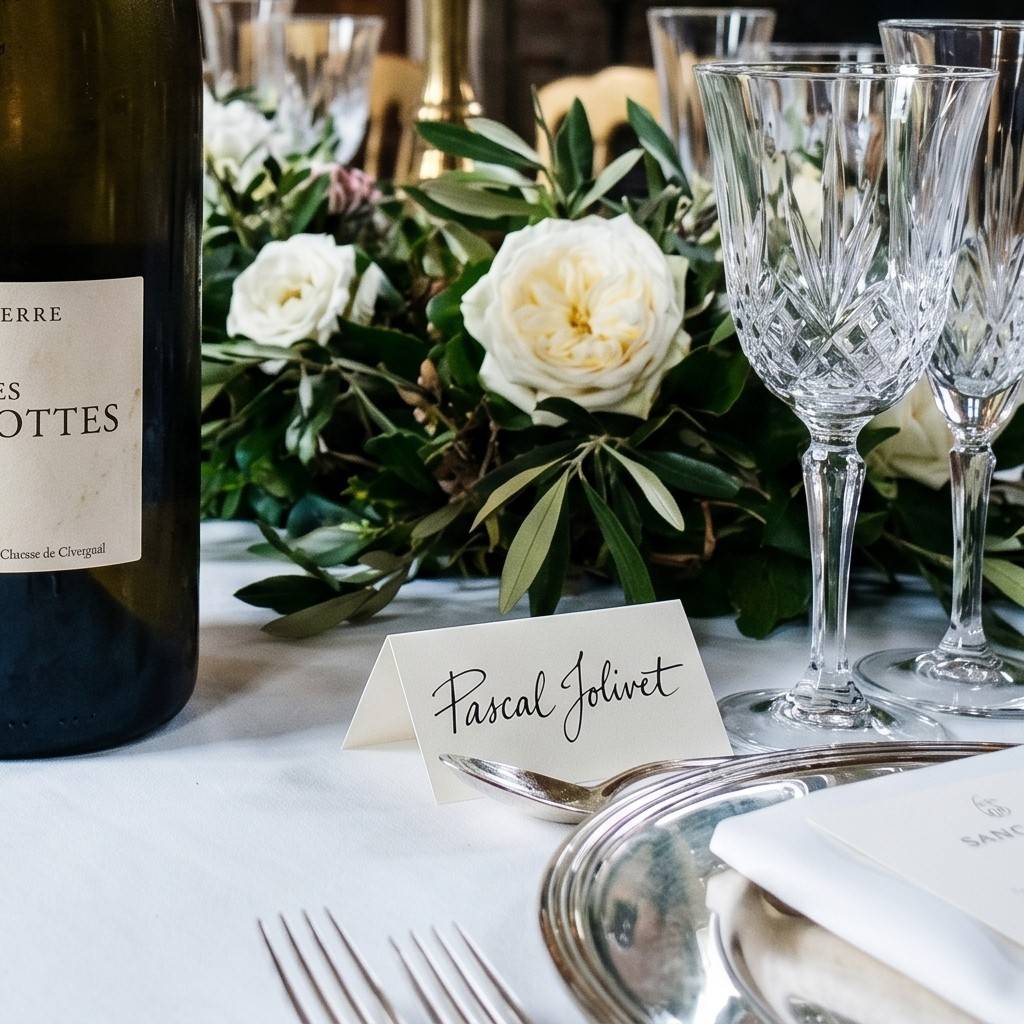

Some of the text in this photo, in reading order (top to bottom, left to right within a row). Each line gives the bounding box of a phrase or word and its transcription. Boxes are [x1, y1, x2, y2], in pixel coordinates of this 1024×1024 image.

[42, 546, 56, 558] de
[432, 650, 684, 743] Pascal Jolivet
